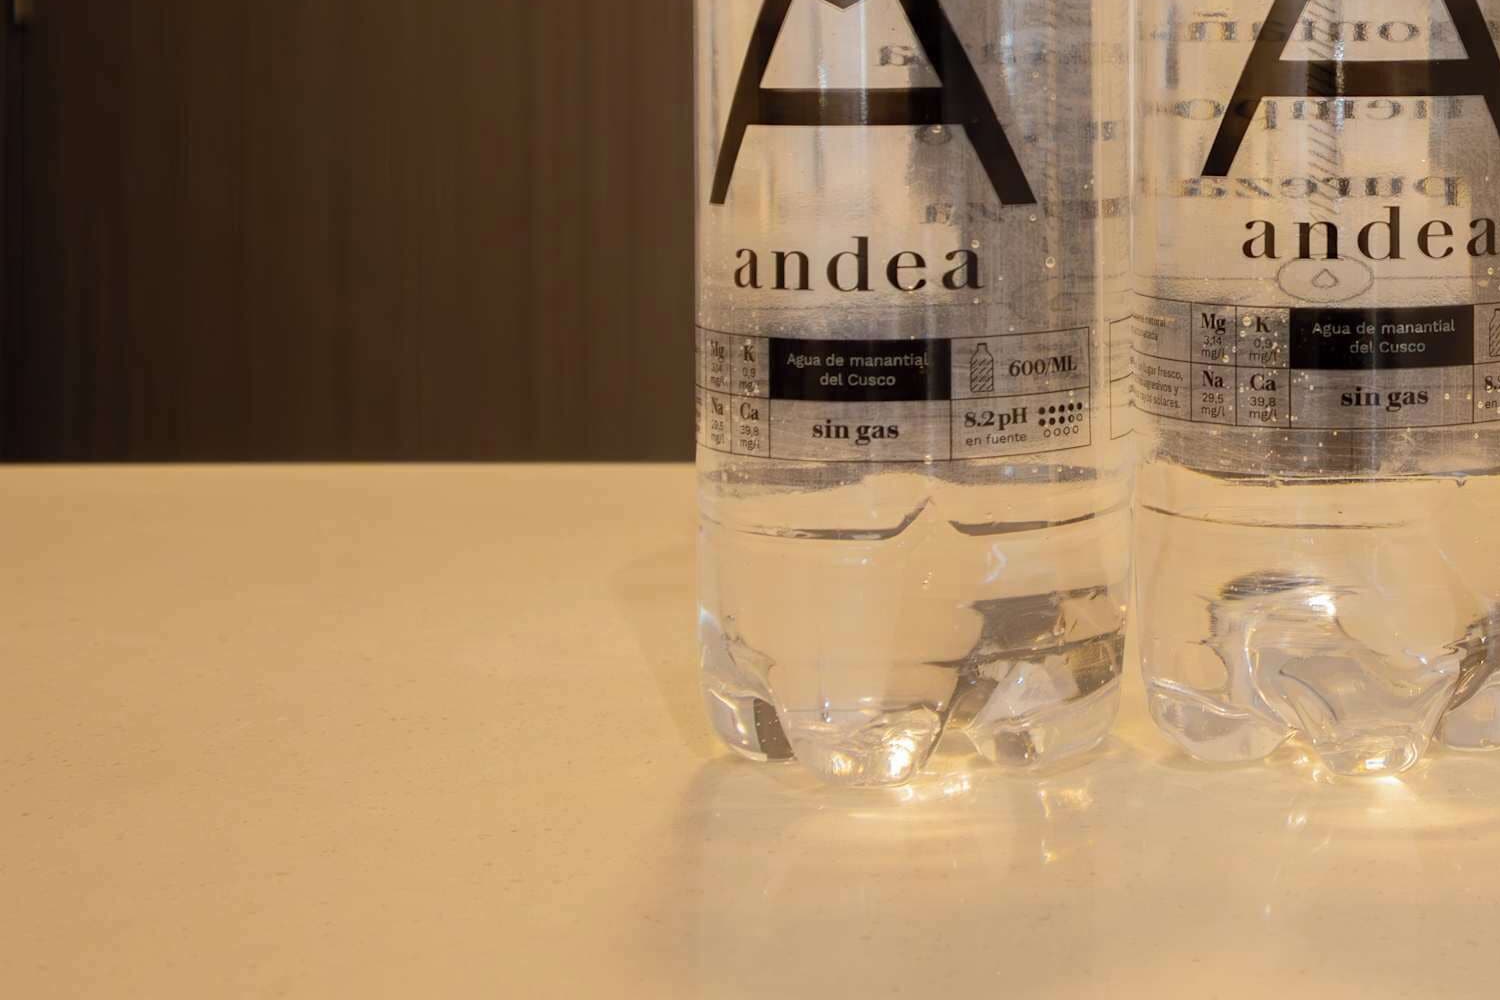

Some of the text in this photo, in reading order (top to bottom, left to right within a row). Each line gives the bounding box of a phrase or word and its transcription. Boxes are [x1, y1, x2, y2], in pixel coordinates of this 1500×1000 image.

[1241, 206, 1500, 261] andea
[733, 236, 985, 293] andea
[1201, 313, 1226, 334] Mg
[1255, 316, 1271, 333] K
[1312, 319, 1456, 338] Agua de manantial
[743, 344, 756, 363] K
[1350, 341, 1425, 354] del Cusco
[787, 351, 929, 369] Agua de manantial
[1008, 354, 1078, 378] 600/ML
[819, 372, 896, 386] del Cusco
[1202, 370, 1225, 389] Na
[1250, 373, 1276, 392] Ca
[1340, 387, 1429, 413] sin gas
[1485, 402, 1499, 411] en
[739, 402, 760, 421] Ca
[963, 406, 1028, 430] 8.2 pH
[812, 419, 899, 446] sin gas
[966, 431, 1028, 447] en fuente
